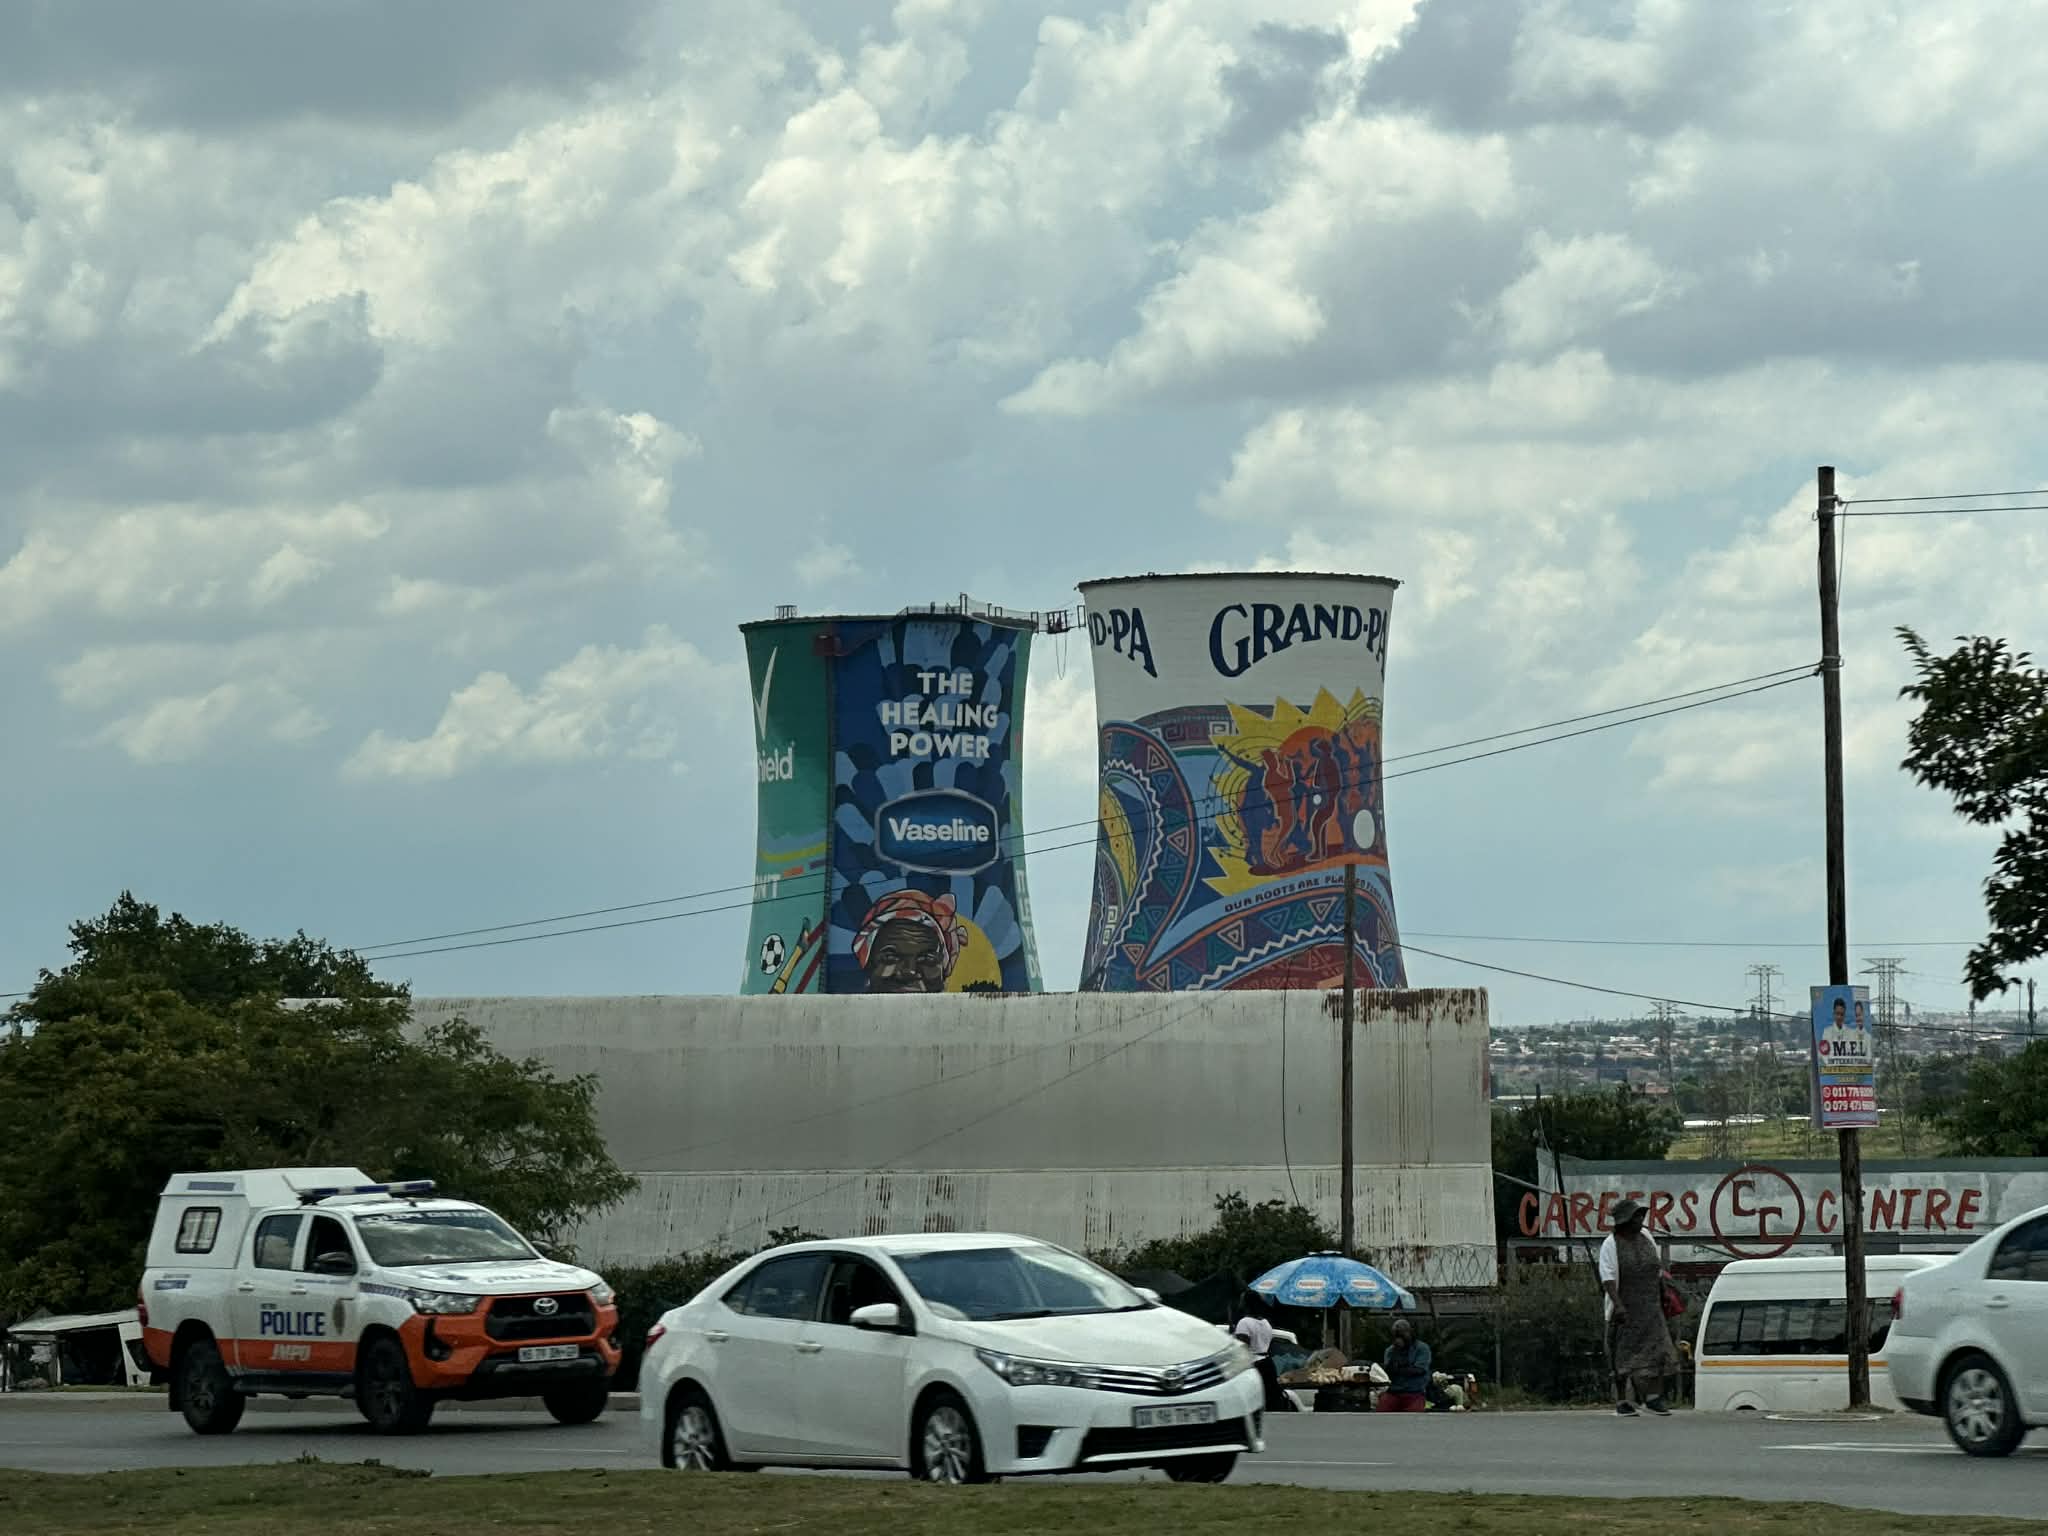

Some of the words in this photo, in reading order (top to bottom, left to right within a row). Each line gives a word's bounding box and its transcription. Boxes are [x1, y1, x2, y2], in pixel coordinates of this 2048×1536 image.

[917, 672, 974, 694] THE
[881, 702, 998, 728] HEALING
[891, 732, 990, 758] POWER
[888, 817, 990, 842] Vaseline
[1224, 898, 1253, 913] OUR
[1255, 885, 1296, 903] ROOTS
[1298, 877, 1320, 889] ARE
[1325, 875, 1366, 889] PLAED
[1518, 1190, 1699, 1237] CARERS
[1816, 1188, 1982, 1234] CNTRE
[260, 1311, 326, 1337] POLICE
